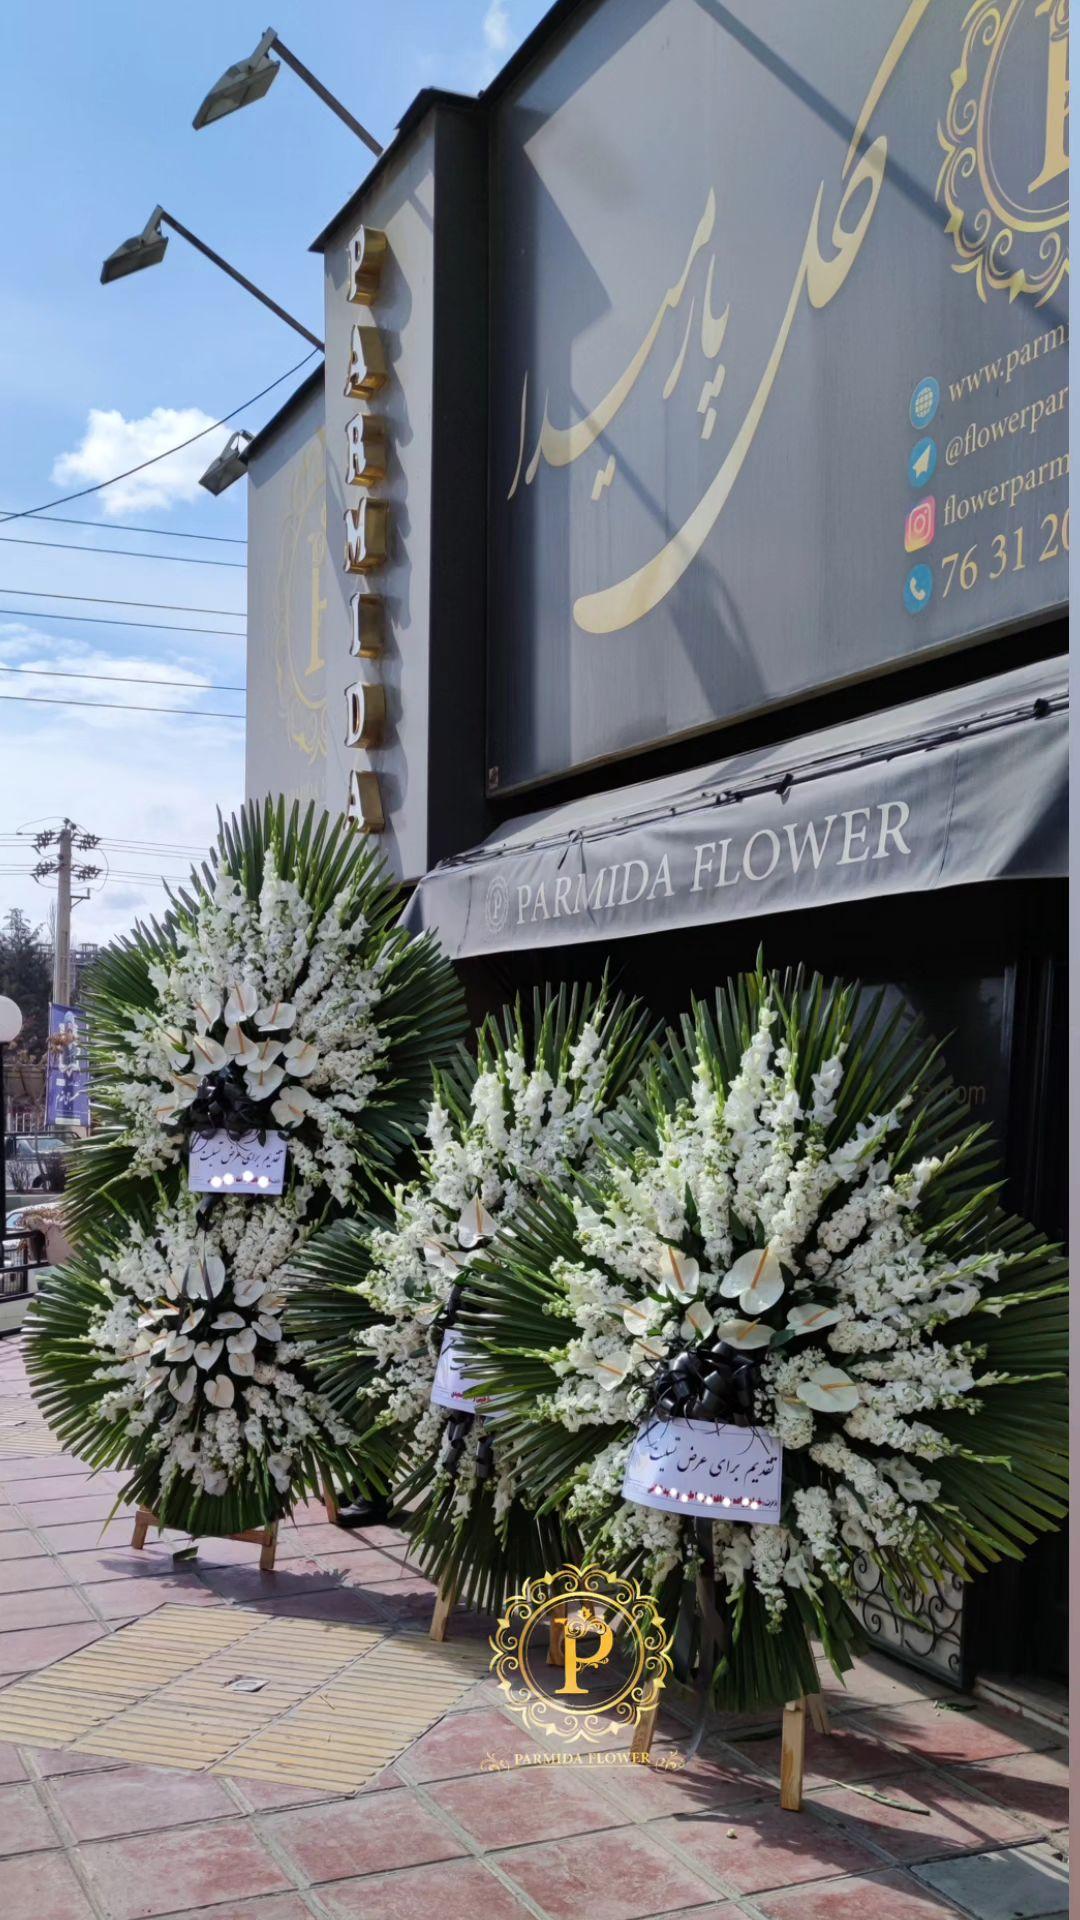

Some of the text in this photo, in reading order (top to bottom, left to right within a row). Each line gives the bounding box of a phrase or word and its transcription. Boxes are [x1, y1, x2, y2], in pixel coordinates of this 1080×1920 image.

[508, 186, 729, 501] پارمیدا
[343, 223, 385, 832] PARMIDA
[941, 543, 979, 598] 76
[989, 526, 1026, 580] 31
[516, 801, 911, 924] PARMIDA FLOWER
[650, 1437, 777, 1486] تقدیم برای عرض تسلیت
